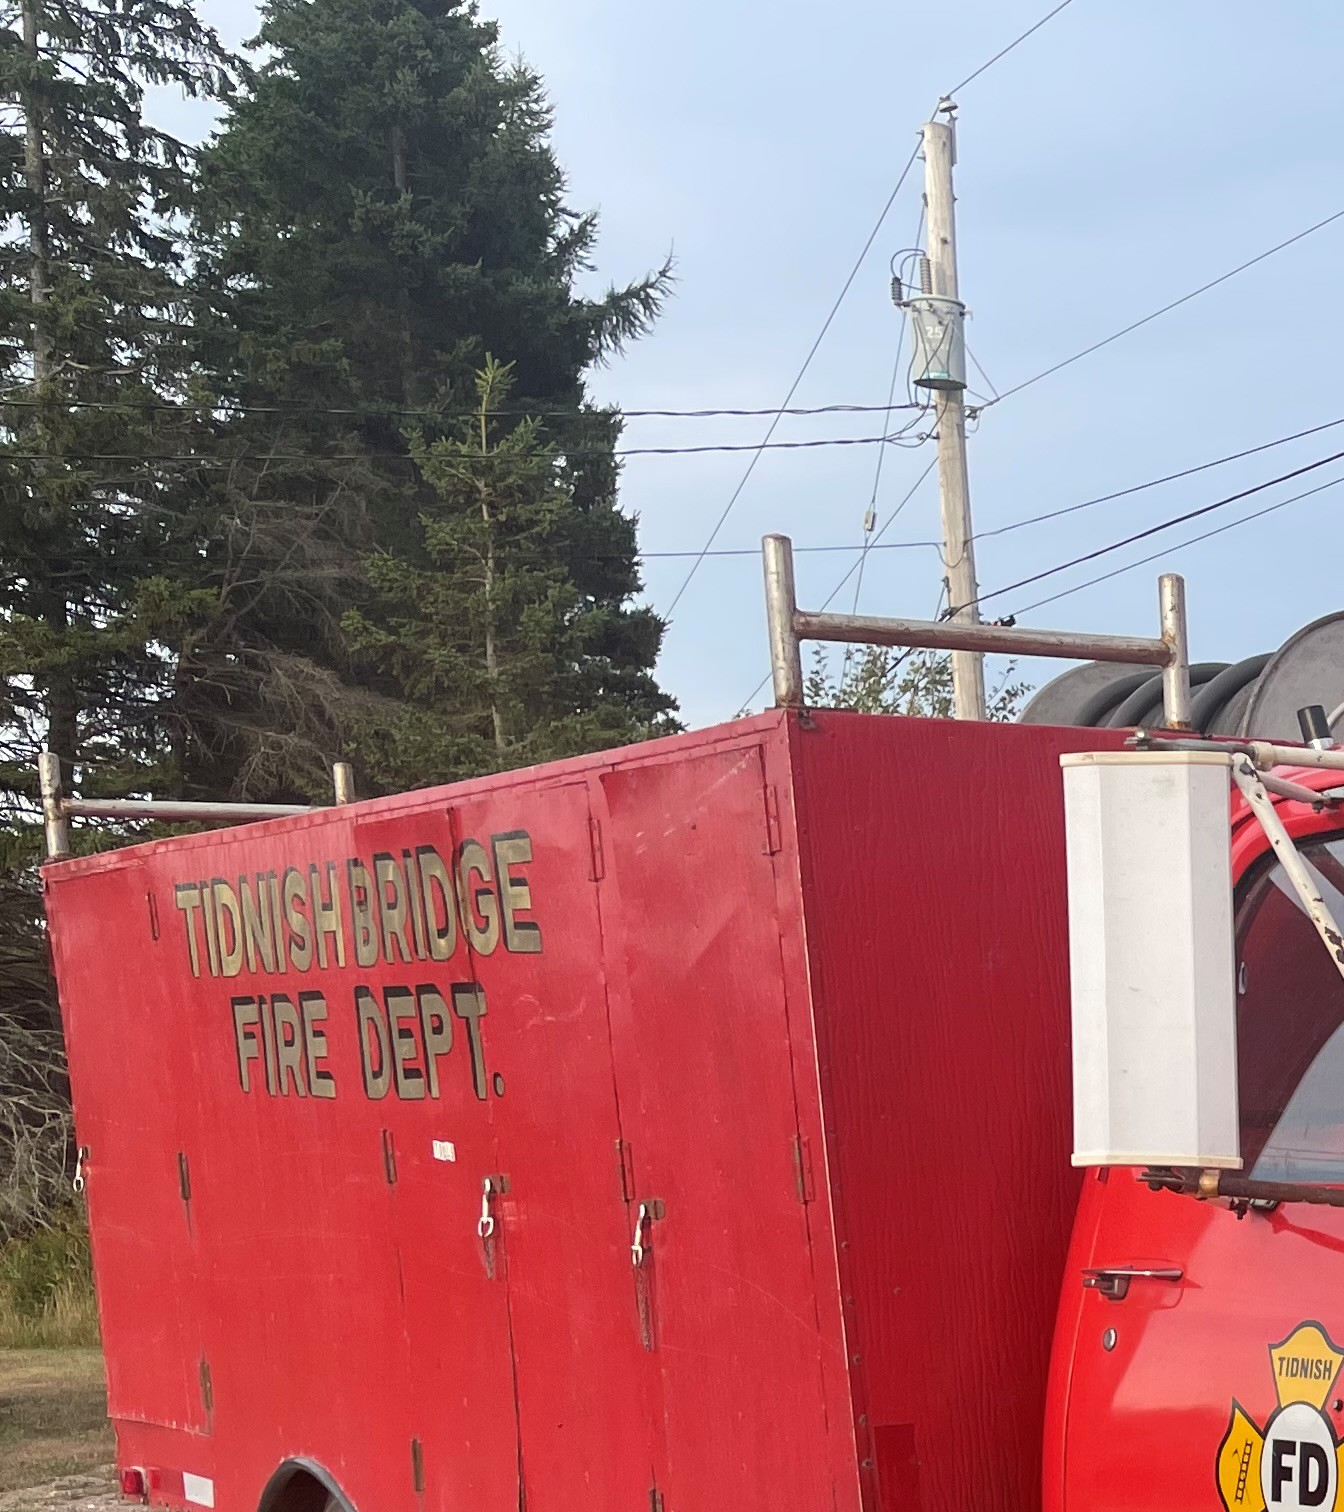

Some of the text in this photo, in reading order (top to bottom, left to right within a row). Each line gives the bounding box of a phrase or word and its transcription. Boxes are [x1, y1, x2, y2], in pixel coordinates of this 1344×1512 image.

[176, 830, 543, 978] TIDNISH BRIDGE
[230, 982, 505, 1101] FIRE DEPT.
[1277, 1356, 1333, 1381] TIDNISH
[1271, 1438, 1330, 1507] FD
